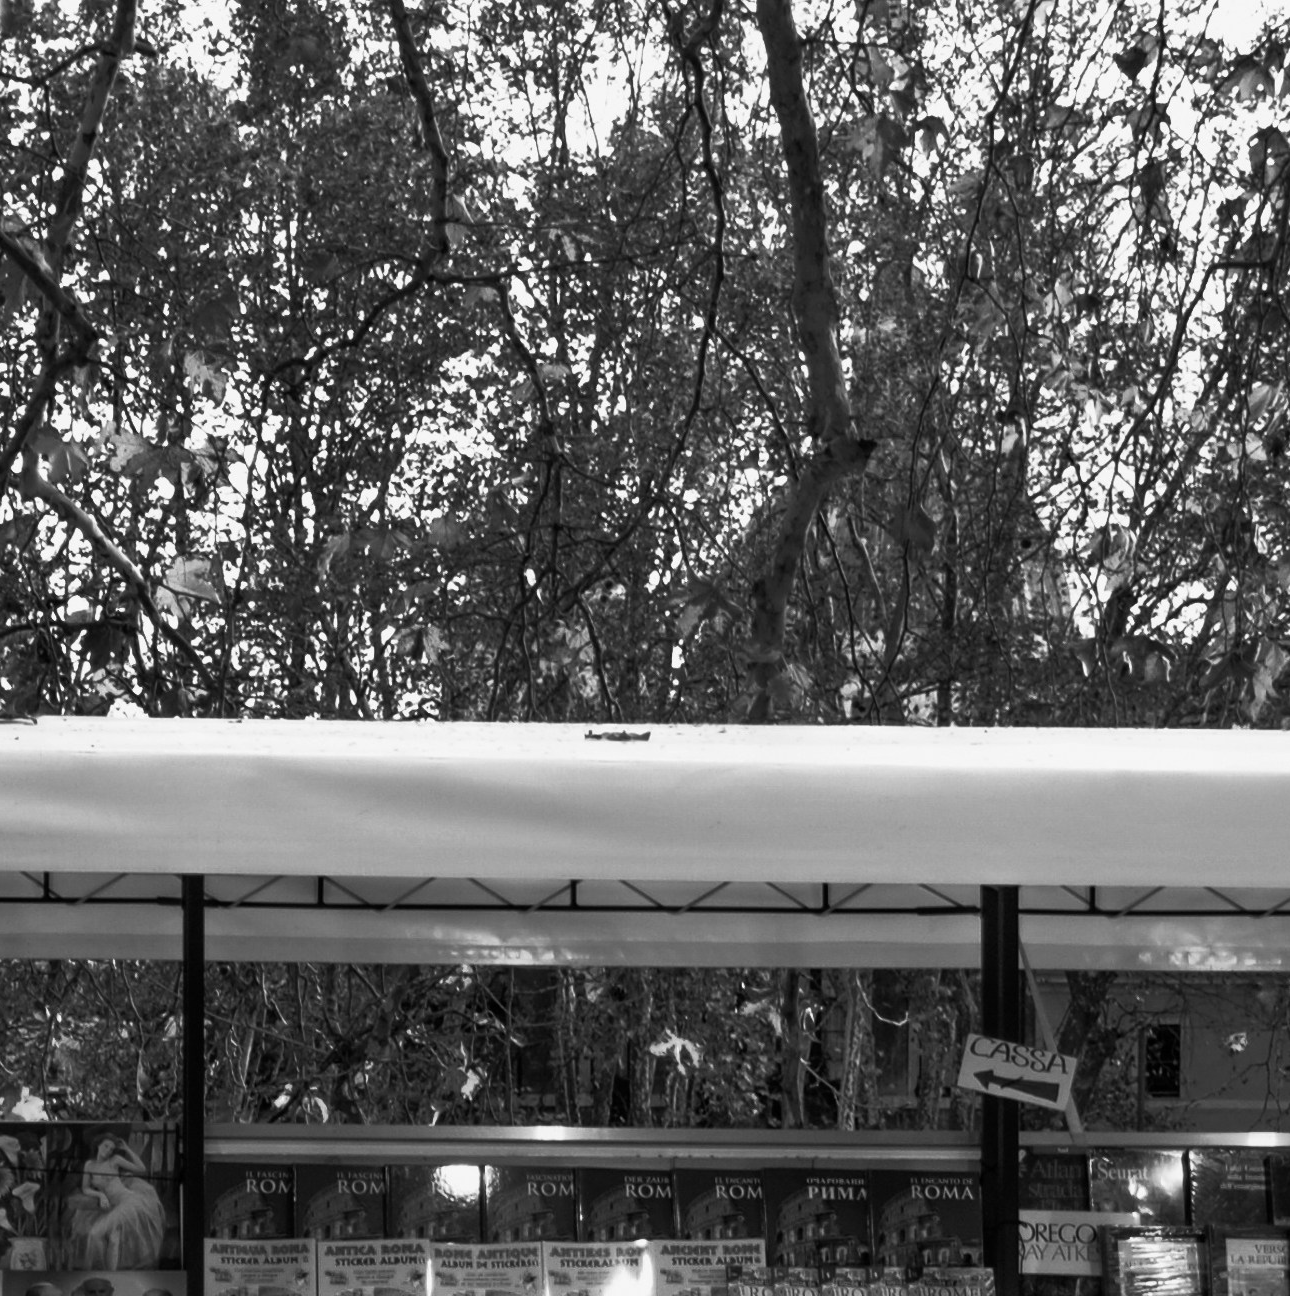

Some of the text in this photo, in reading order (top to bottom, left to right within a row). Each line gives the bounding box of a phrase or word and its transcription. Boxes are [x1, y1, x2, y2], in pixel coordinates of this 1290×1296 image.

[970, 1037, 1068, 1075] CASSA
[1097, 1162, 1148, 1180] Seurat
[911, 1185, 974, 1200] ROMA
